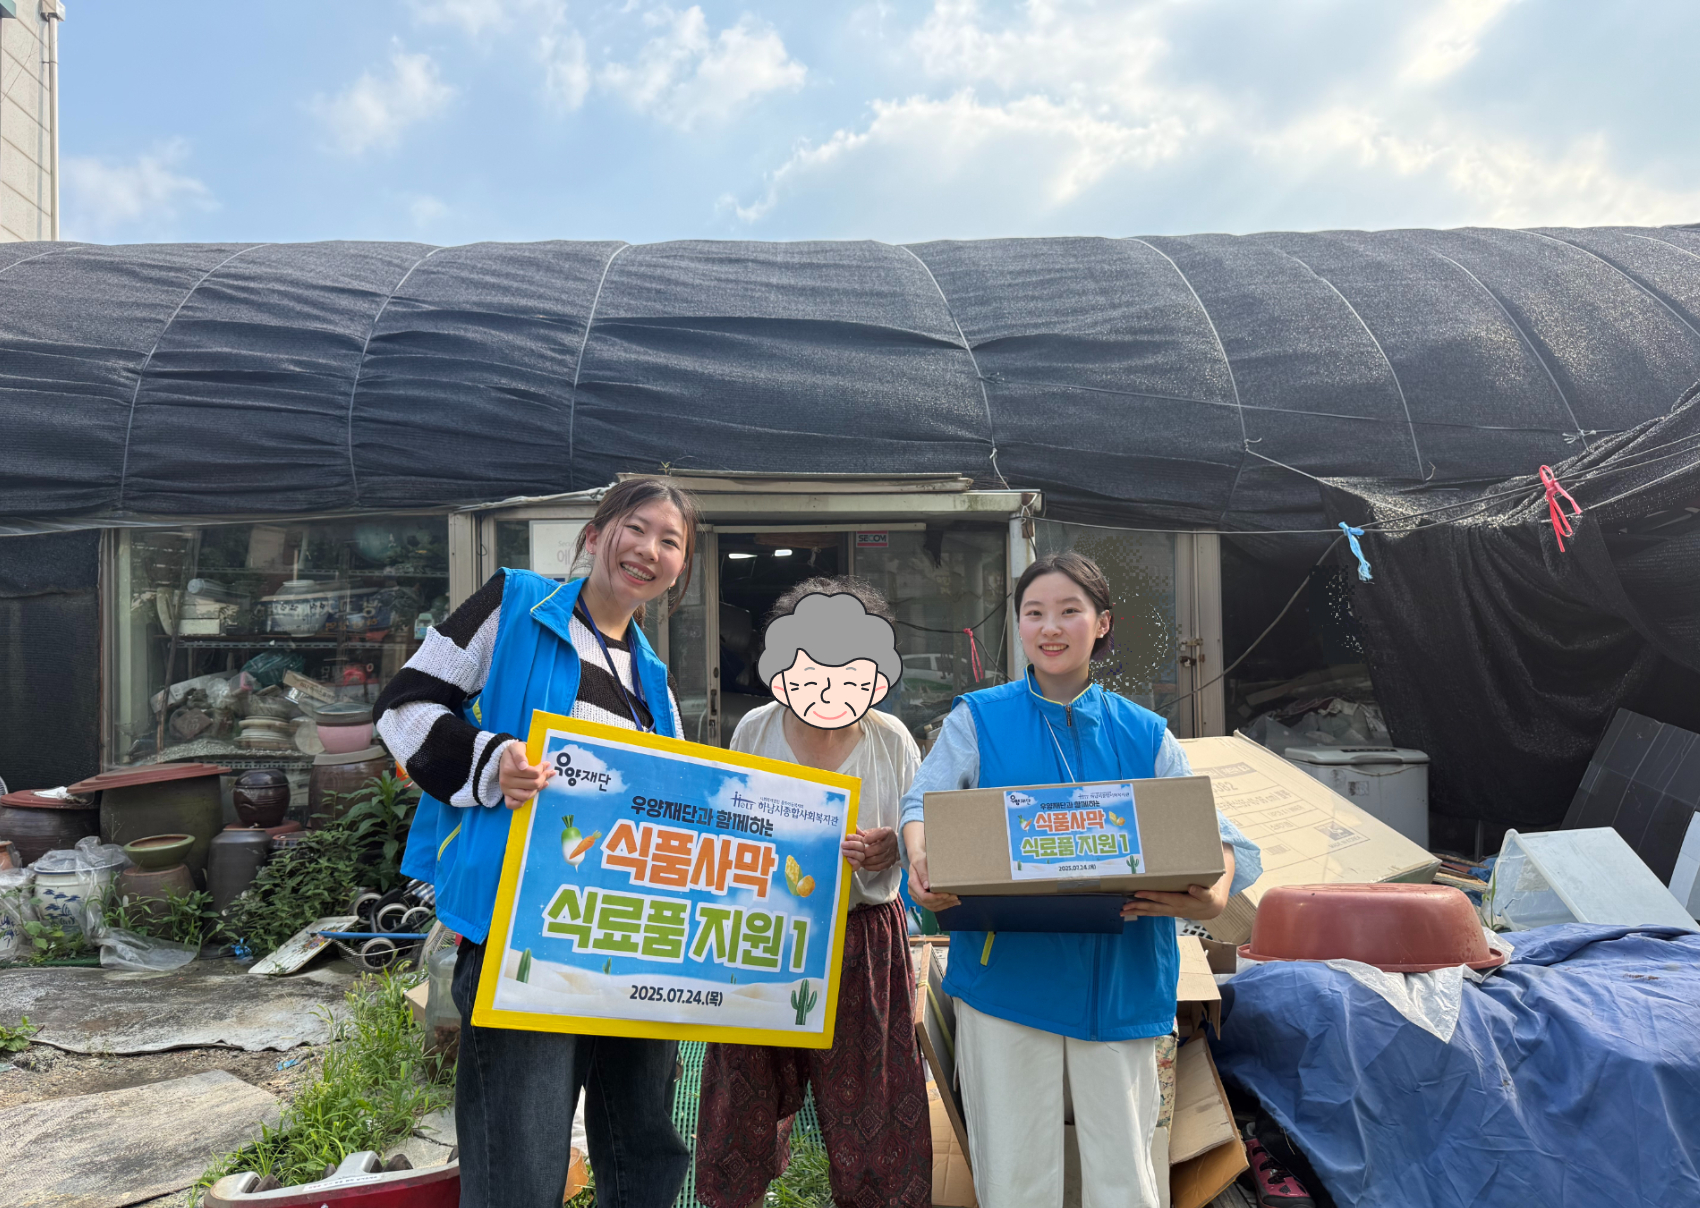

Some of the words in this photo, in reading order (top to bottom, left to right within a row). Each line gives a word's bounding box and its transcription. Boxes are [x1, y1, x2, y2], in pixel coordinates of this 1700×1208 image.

[858, 534, 887, 542] SECOM
[554, 752, 611, 792] 우양재단
[631, 795, 714, 827] 우양재단과
[716, 809, 774, 837] 함께하는
[758, 801, 839, 827] 하남시종합사회복지관
[1035, 810, 1105, 832] 식품사막
[1021, 836, 1074, 857] 식료품
[1077, 833, 1118, 855] 지원
[1119, 834, 1130, 853] 1
[603, 821, 777, 898] 식품사막
[547, 888, 688, 960] 식료품
[692, 906, 784, 969] 지원
[789, 919, 808, 970] 1
[629, 984, 724, 1007] 2025.07.24.(목)
